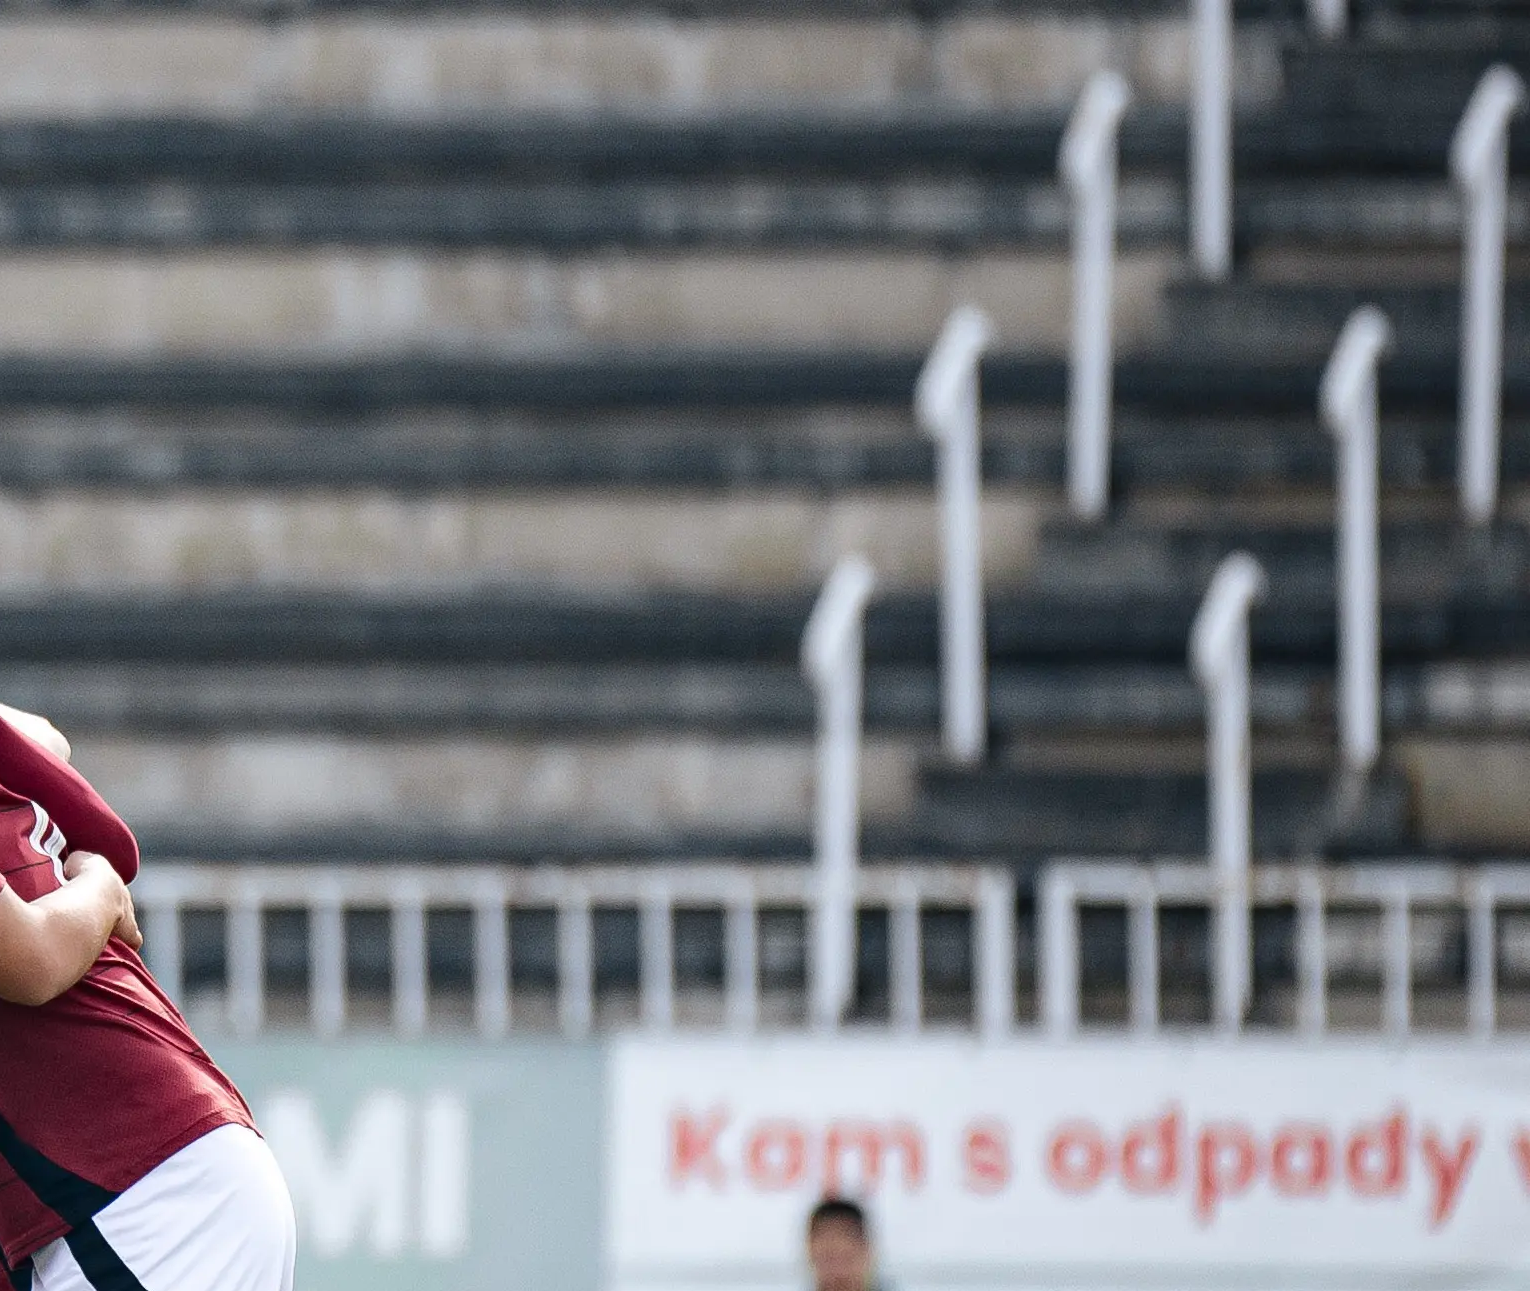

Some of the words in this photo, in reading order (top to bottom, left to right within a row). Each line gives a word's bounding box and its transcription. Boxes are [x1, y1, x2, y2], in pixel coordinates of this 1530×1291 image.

[667, 1104, 925, 1194] Kam
[963, 1117, 1010, 1196] s
[1046, 1101, 1480, 1233] odpady
